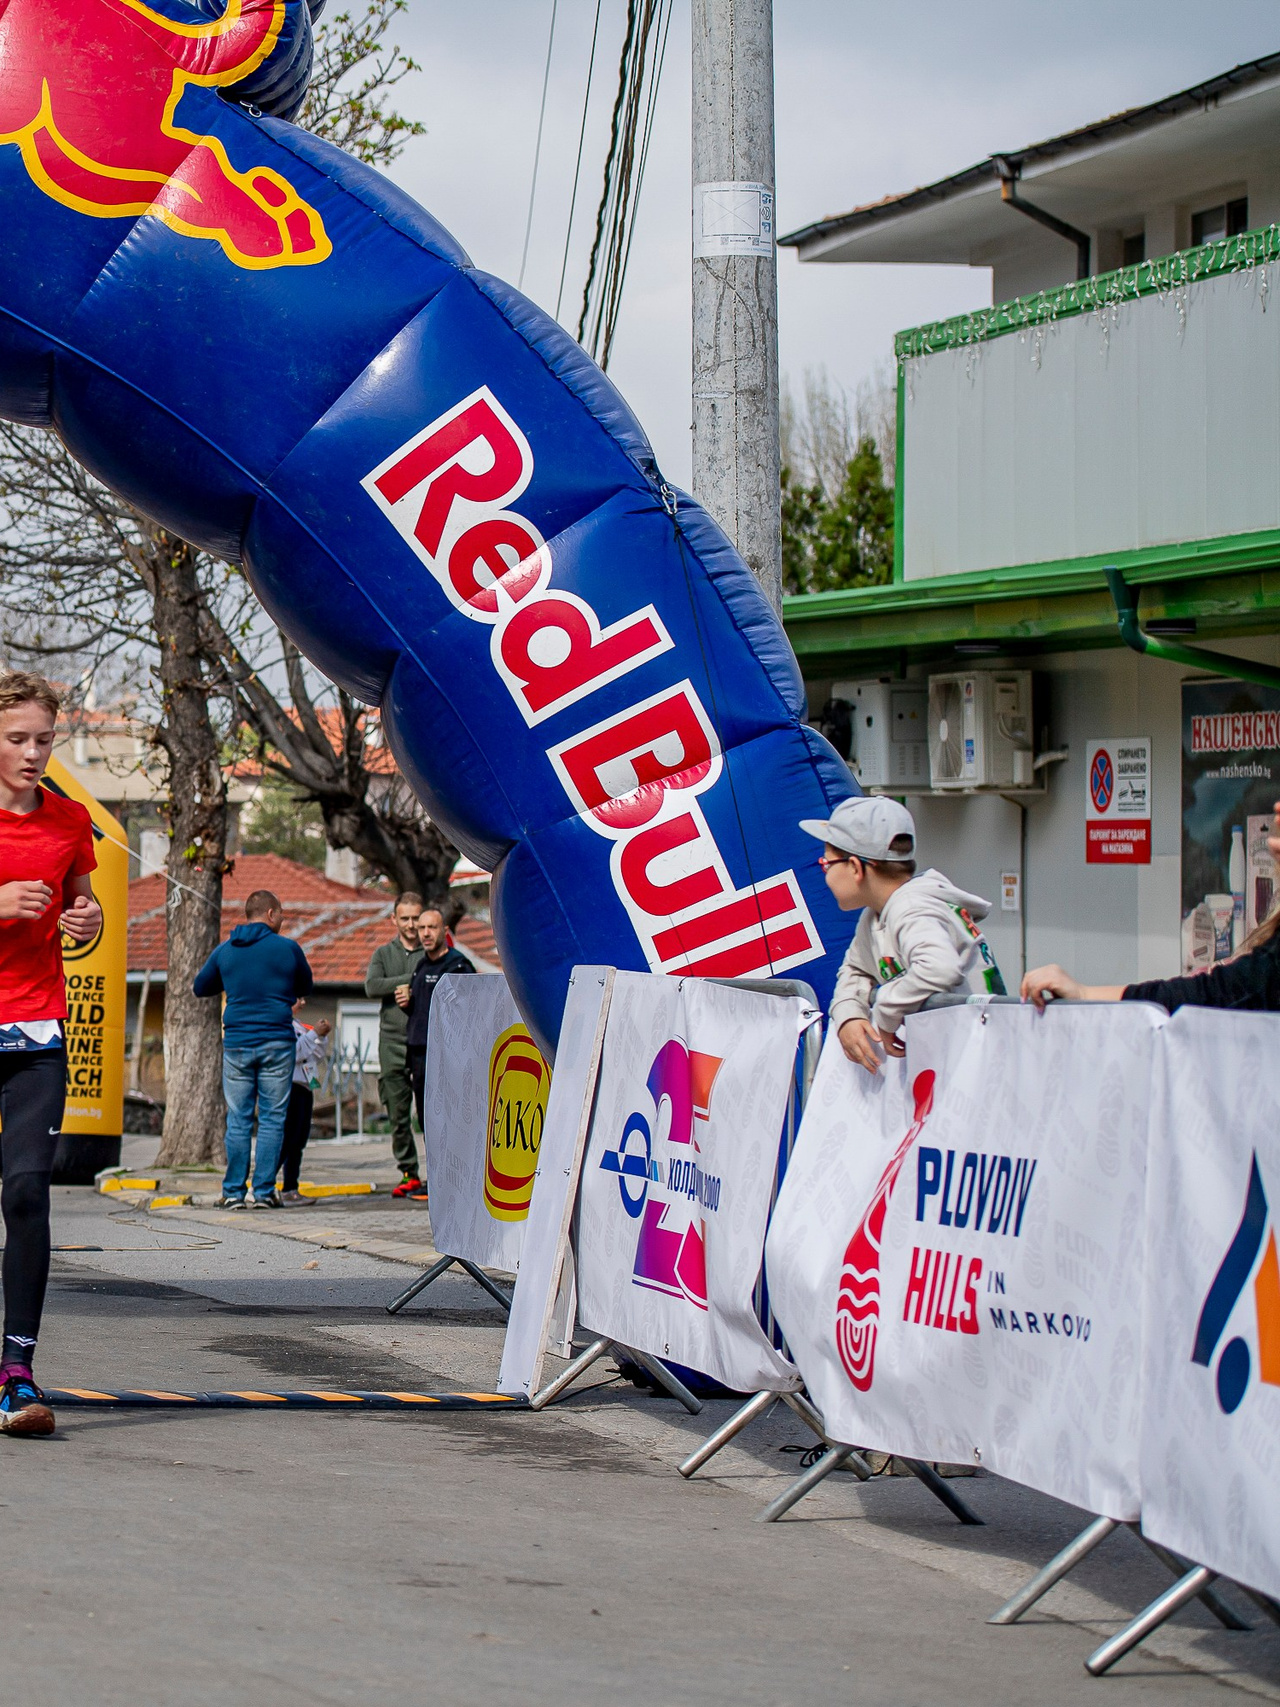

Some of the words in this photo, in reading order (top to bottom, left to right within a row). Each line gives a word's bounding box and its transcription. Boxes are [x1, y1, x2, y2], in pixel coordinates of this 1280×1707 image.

[360, 385, 675, 729] Red
[545, 678, 826, 978] Bull
[1192, 711, 1280, 752] НАШЕНСК
[64, 974, 105, 990] OSE
[67, 991, 105, 1003] LENCE
[66, 1003, 105, 1024] ILD
[67, 1026, 104, 1037] LENCE
[68, 1038, 103, 1054] INE
[67, 1055, 103, 1066] LENCE
[66, 1086, 102, 1098] LENCE
[915, 1146, 1038, 1237] PLOVDIV
[903, 1246, 983, 1335] HILLS
[987, 1270, 1006, 1294] IN
[989, 1307, 1091, 1342] MARKOVO
